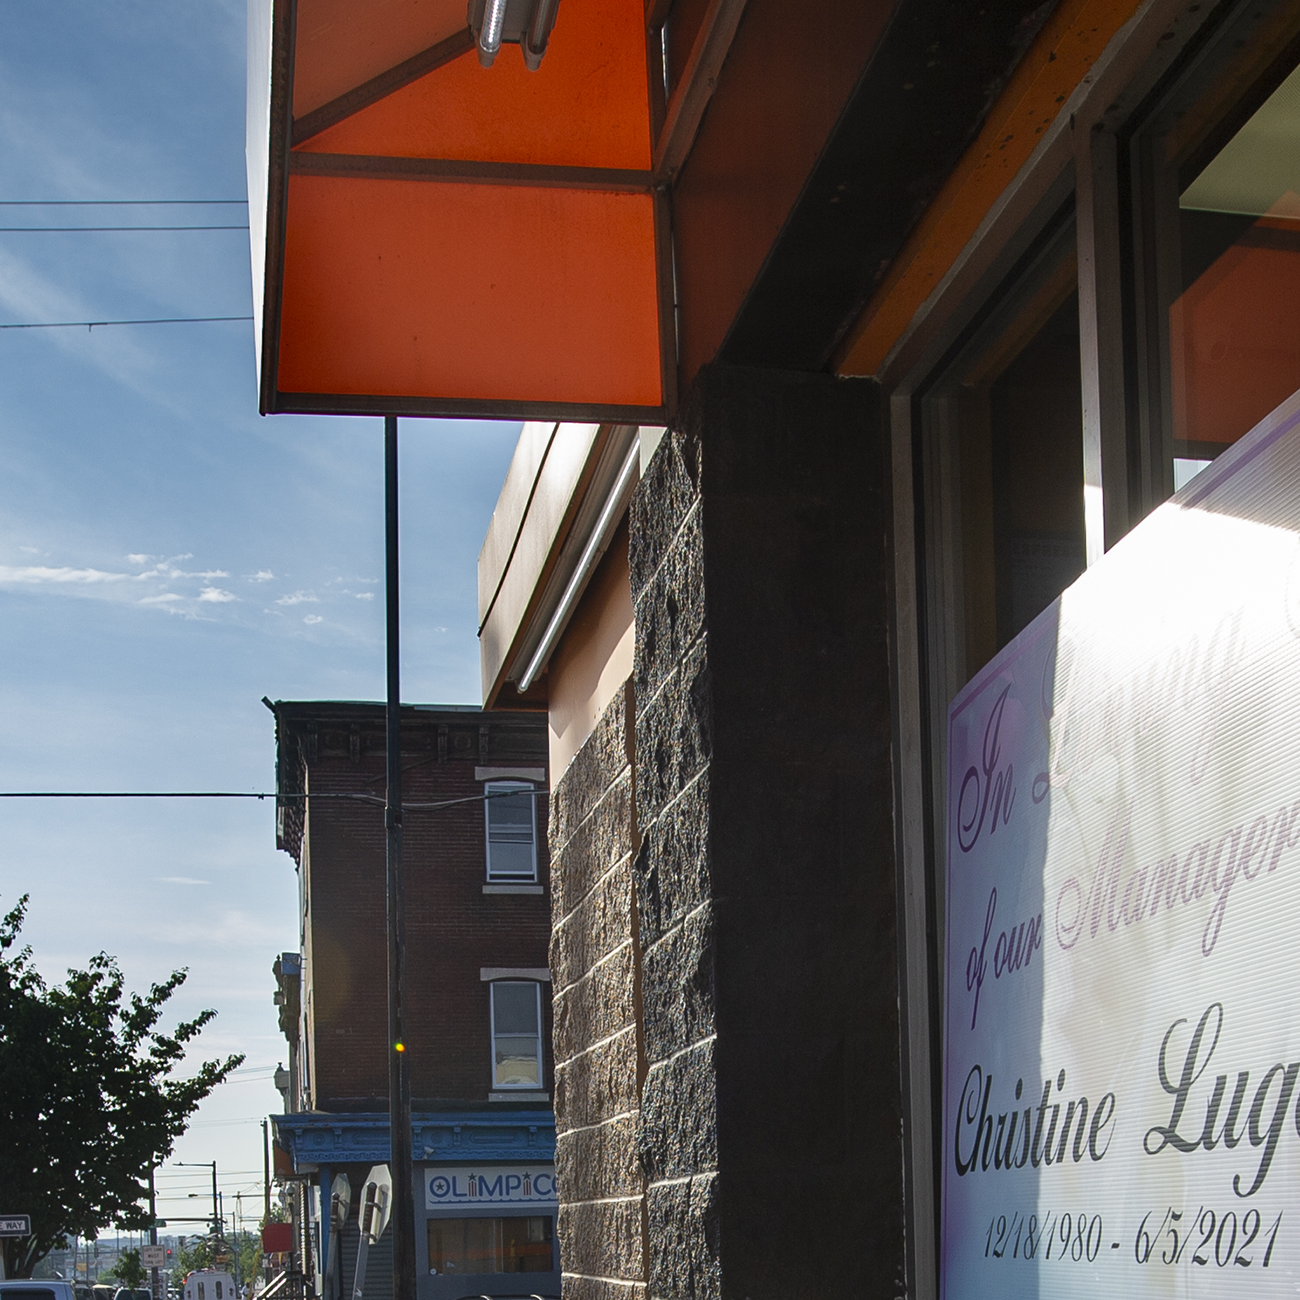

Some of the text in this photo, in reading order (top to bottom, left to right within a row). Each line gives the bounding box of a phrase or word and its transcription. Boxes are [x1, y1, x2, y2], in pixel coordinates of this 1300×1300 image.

[957, 684, 1018, 852] In
[966, 800, 1300, 1030] of our Manager
[955, 1064, 1117, 1176] Christine
[5, 1221, 23, 1230] WAY
[984, 1210, 1103, 1263] 12/18/1980
[1135, 1205, 1284, 1268] 6/5/2021
